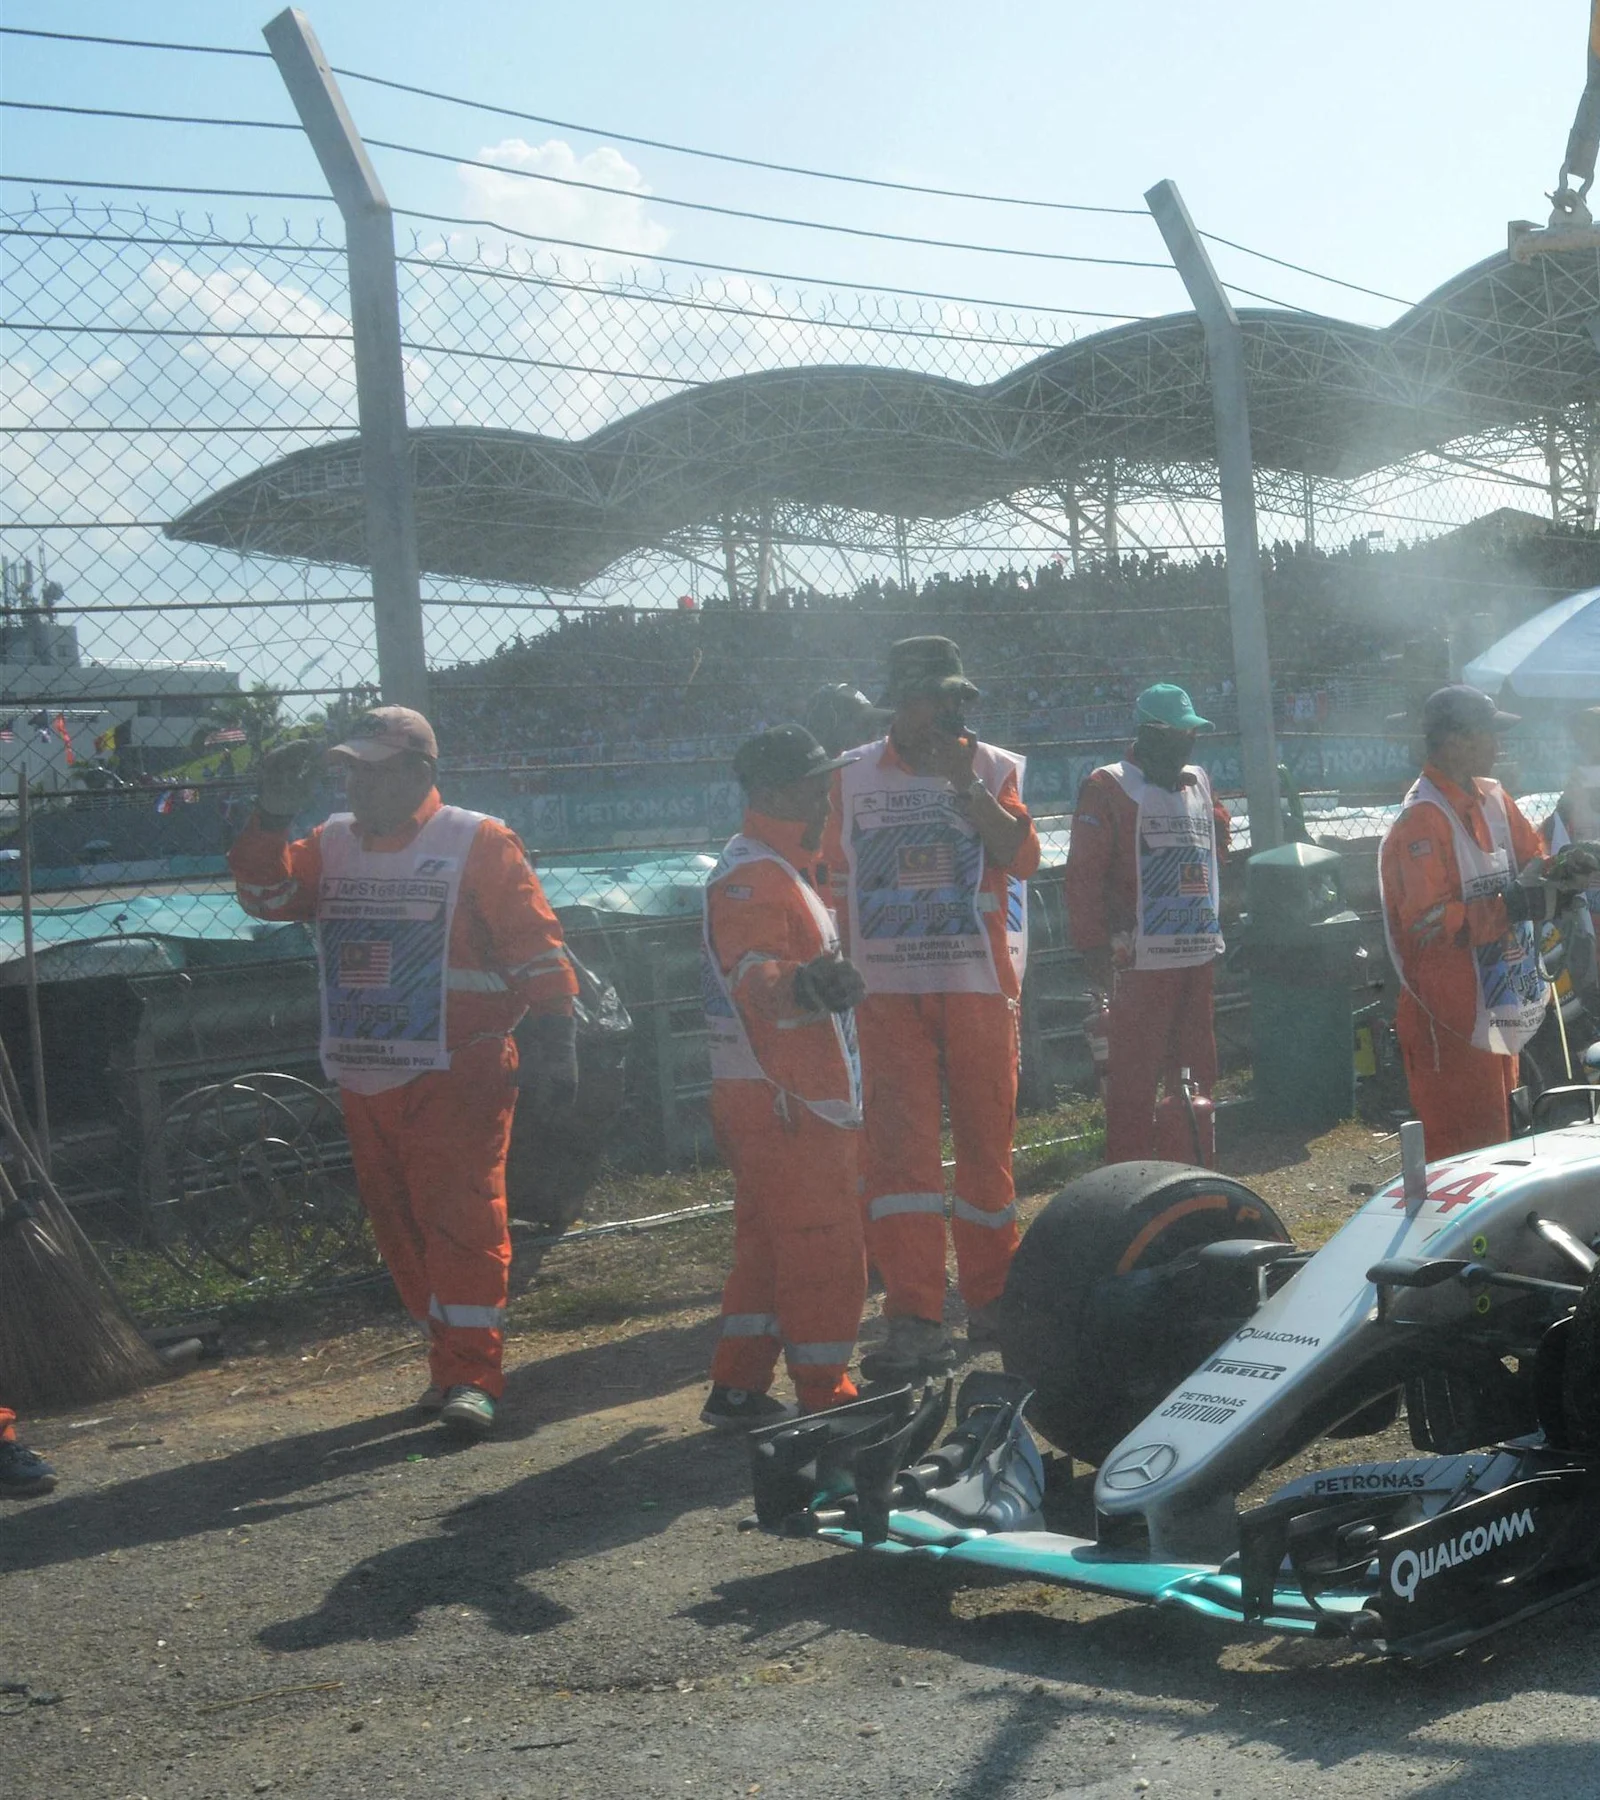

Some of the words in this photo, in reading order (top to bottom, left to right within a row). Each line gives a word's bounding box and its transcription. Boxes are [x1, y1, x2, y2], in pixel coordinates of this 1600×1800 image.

[575, 796, 697, 824] PETRONAS
[1235, 1327, 1321, 1347] QUALCOMM
[1203, 1357, 1287, 1381] PIRELLI
[1178, 1391, 1247, 1407] PETRONAS
[1161, 1401, 1236, 1425] SYNTIUM
[1314, 1473, 1425, 1494] PETRONAS
[1390, 1507, 1536, 1603] QUALCOMM
